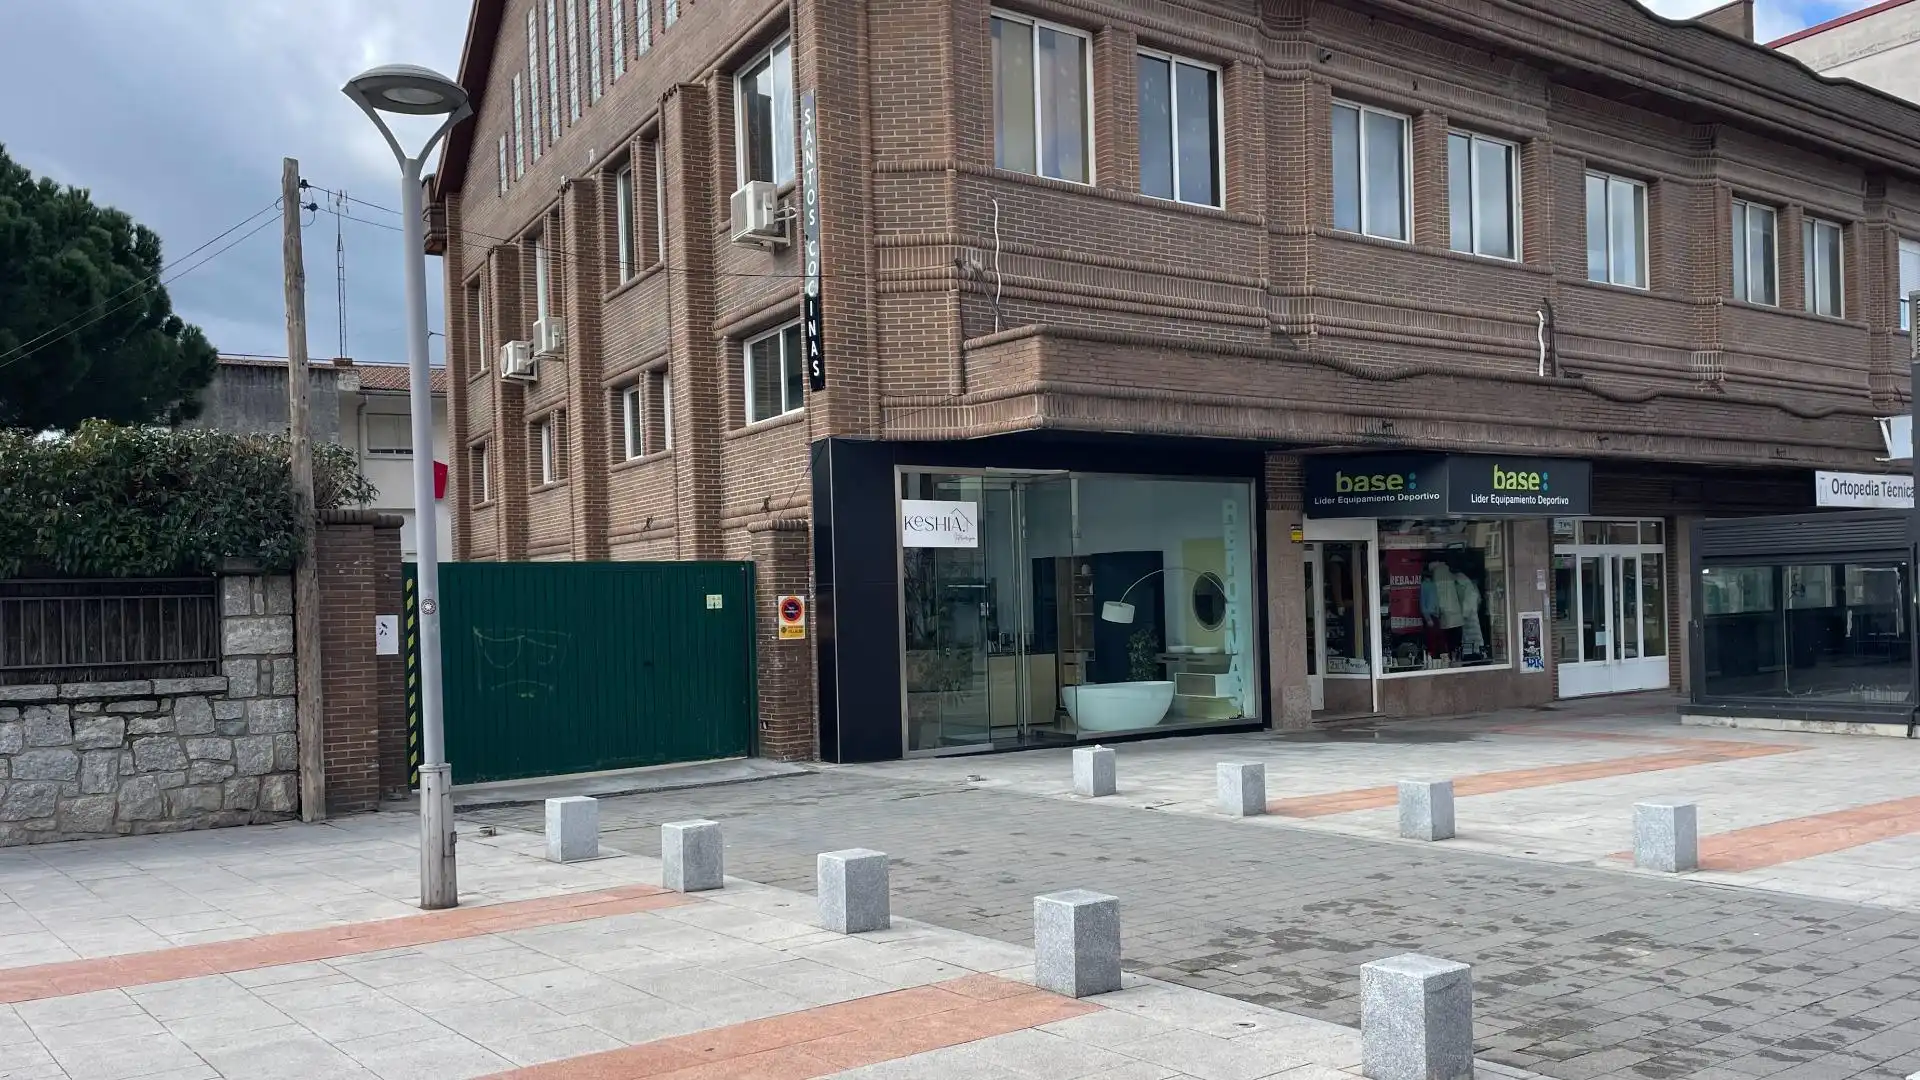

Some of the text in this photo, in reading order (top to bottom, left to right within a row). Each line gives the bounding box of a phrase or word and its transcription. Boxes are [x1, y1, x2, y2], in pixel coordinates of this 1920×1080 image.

[804, 108, 820, 376] SANTOS COCINAS
[1831, 478, 1880, 499] Ortopedia
[1337, 494, 1396, 504] Equipamiento
[1397, 492, 1440, 501] Deportivo
[1490, 494, 1537, 505] Equipamiento
[1537, 495, 1569, 506] Deportivo
